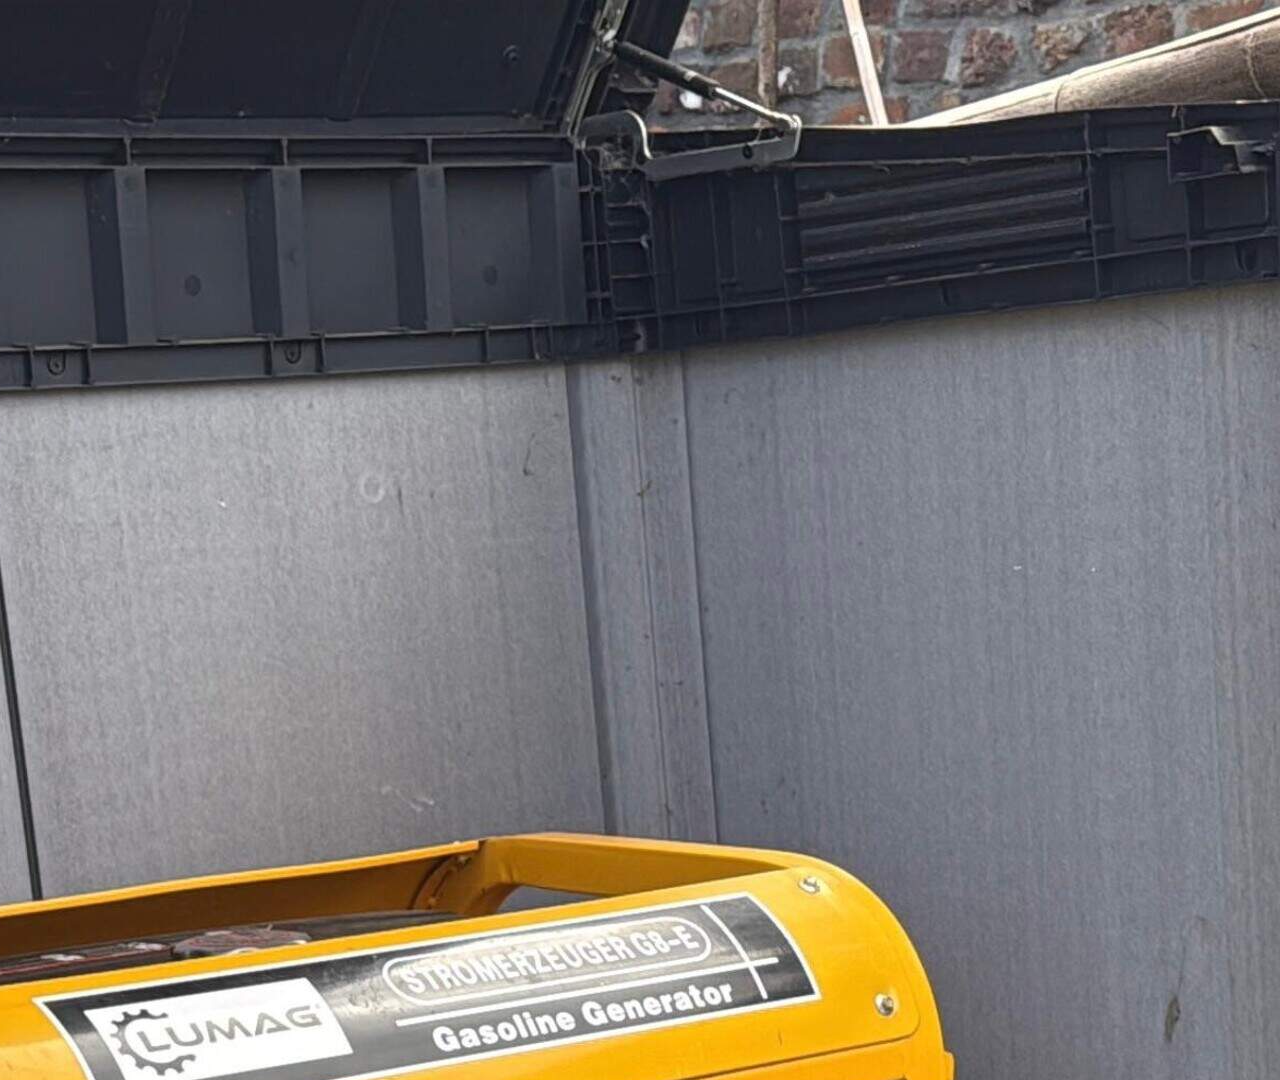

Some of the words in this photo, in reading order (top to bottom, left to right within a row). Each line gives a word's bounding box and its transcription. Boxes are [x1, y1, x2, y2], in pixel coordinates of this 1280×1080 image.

[399, 935, 637, 993] STROMERZEUGER
[632, 924, 701, 958] G8-E
[136, 1004, 324, 1053] LUMAG
[432, 1009, 577, 1053] Gasoline
[581, 982, 735, 1027] Generator
